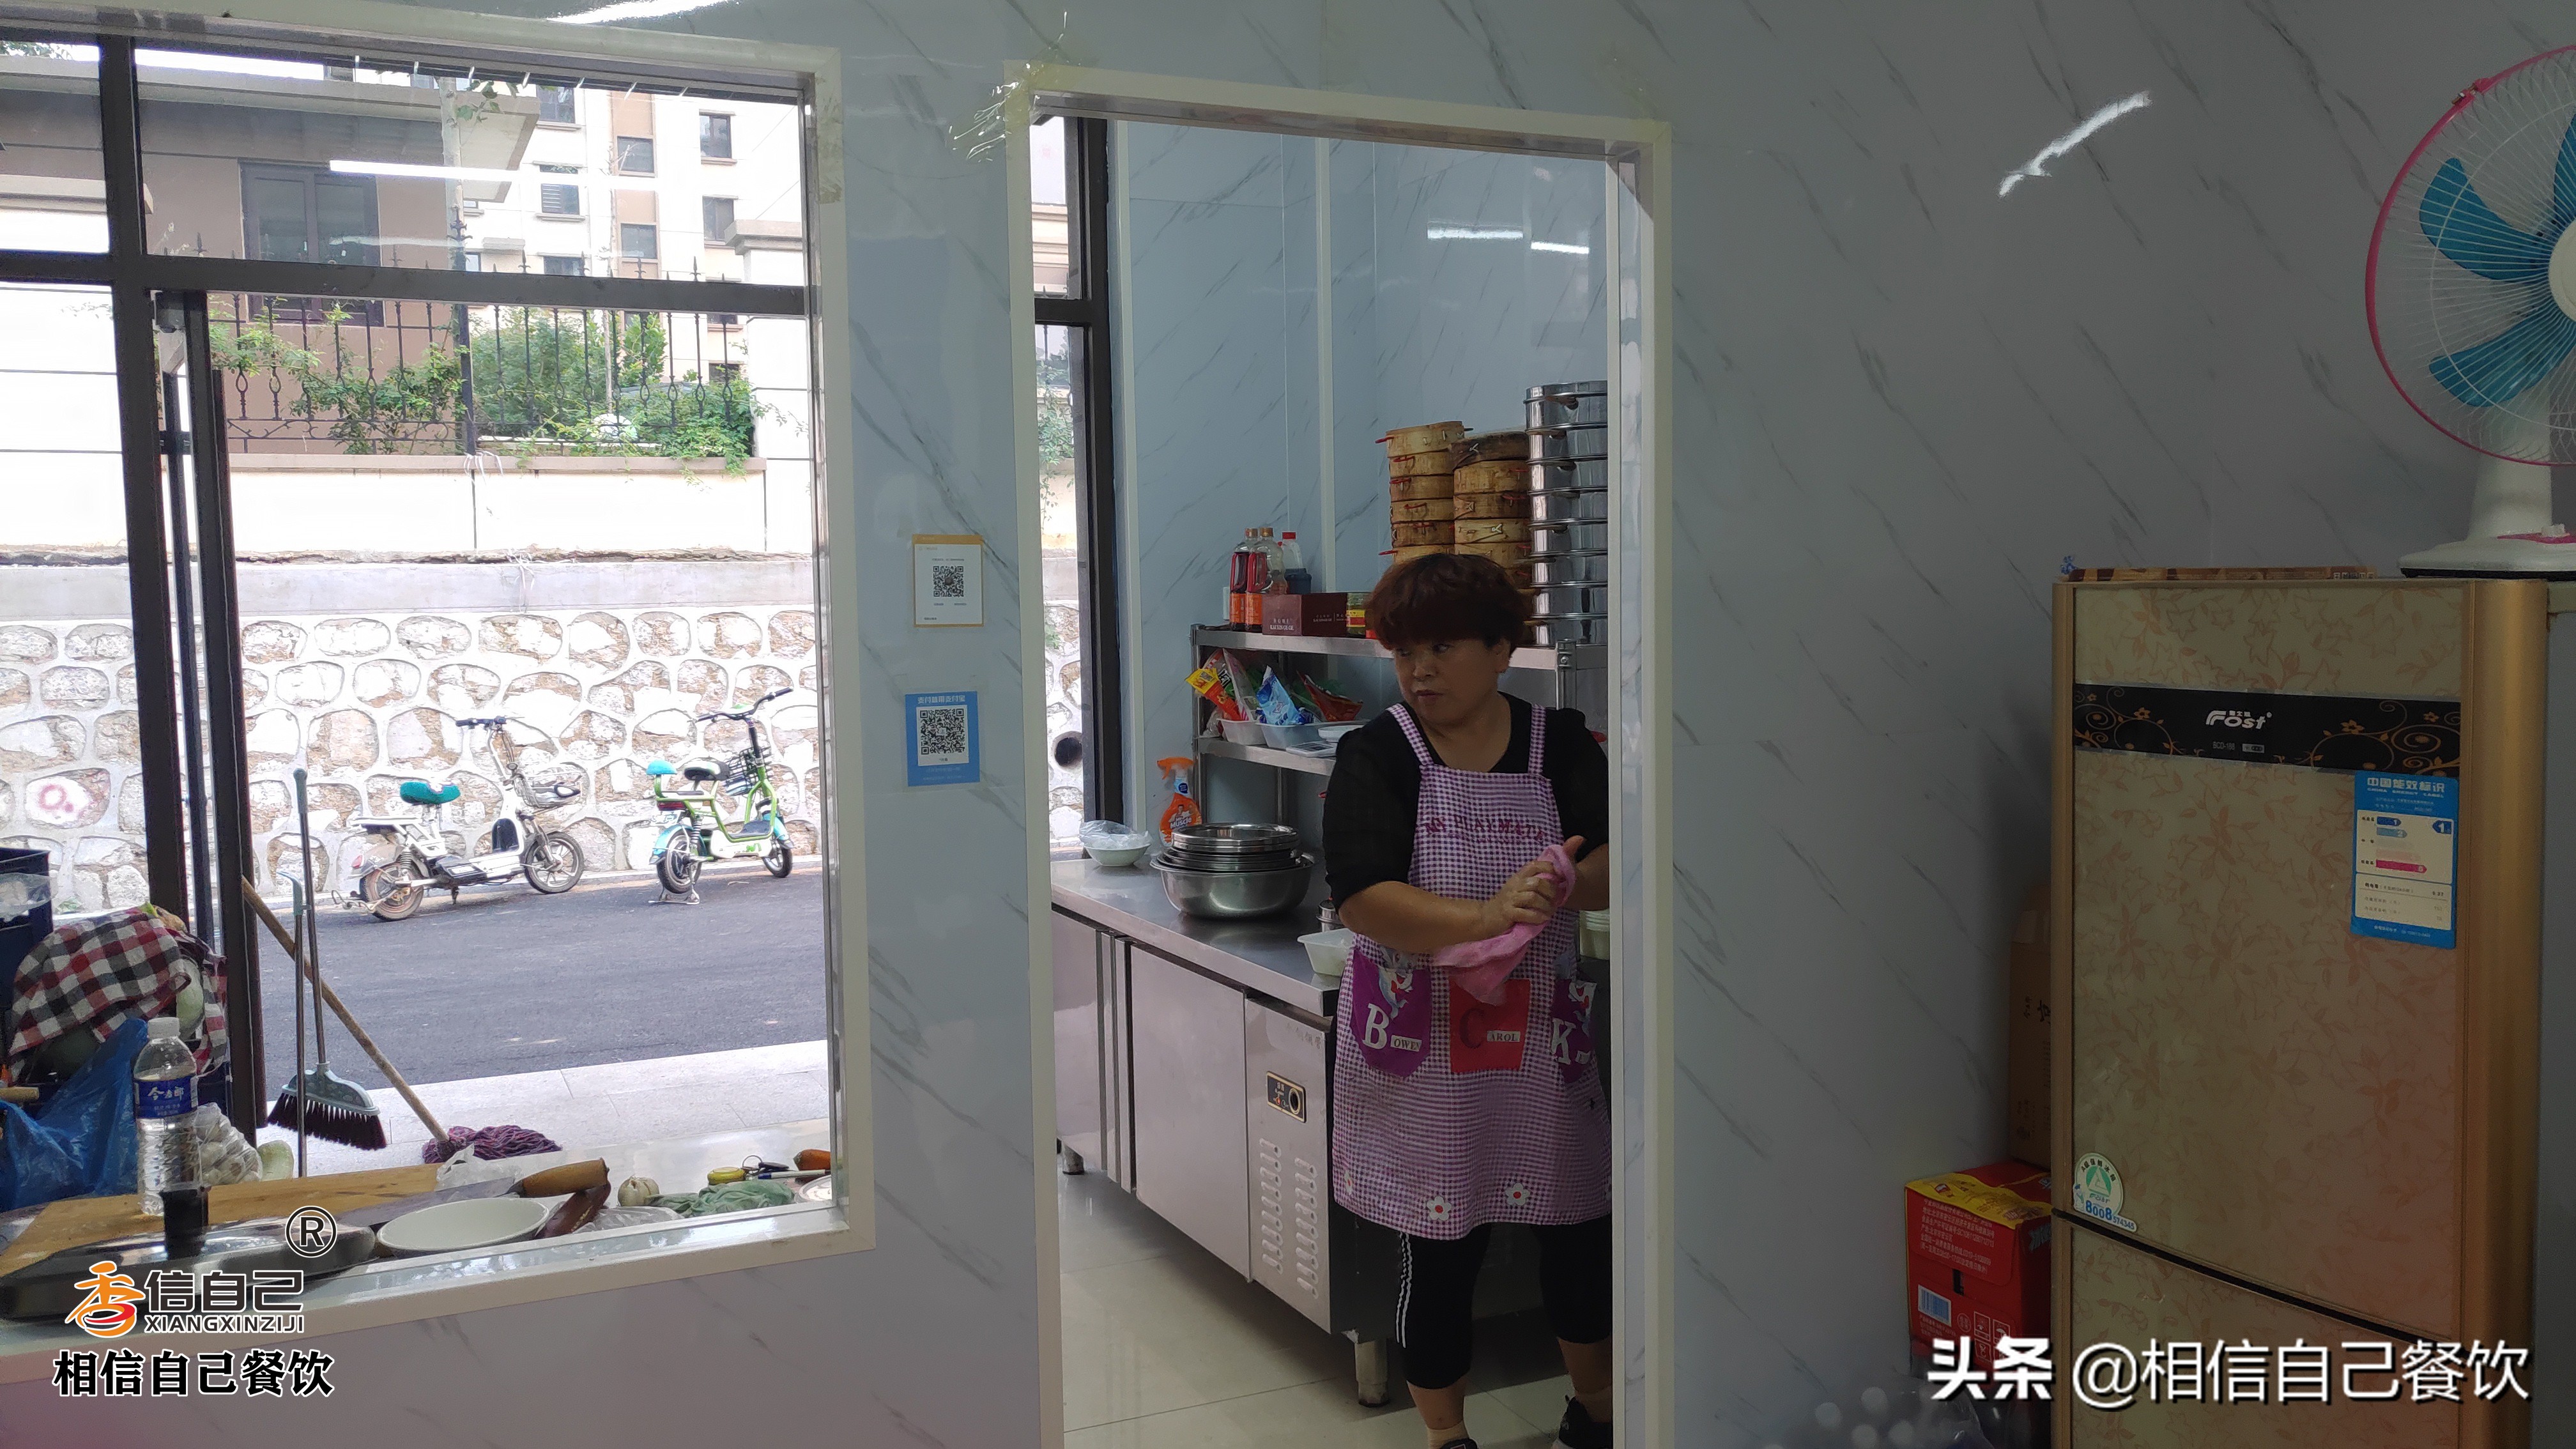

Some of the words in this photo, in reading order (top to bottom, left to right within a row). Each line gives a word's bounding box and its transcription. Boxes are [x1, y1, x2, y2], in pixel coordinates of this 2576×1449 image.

[2367, 778, 2445, 792] 中国能效标识
[1170, 817, 1192, 829] Muscle
[1361, 1002, 1390, 1050] B
[1551, 1017, 1577, 1066] K
[2085, 1200, 2112, 1221] 8008
